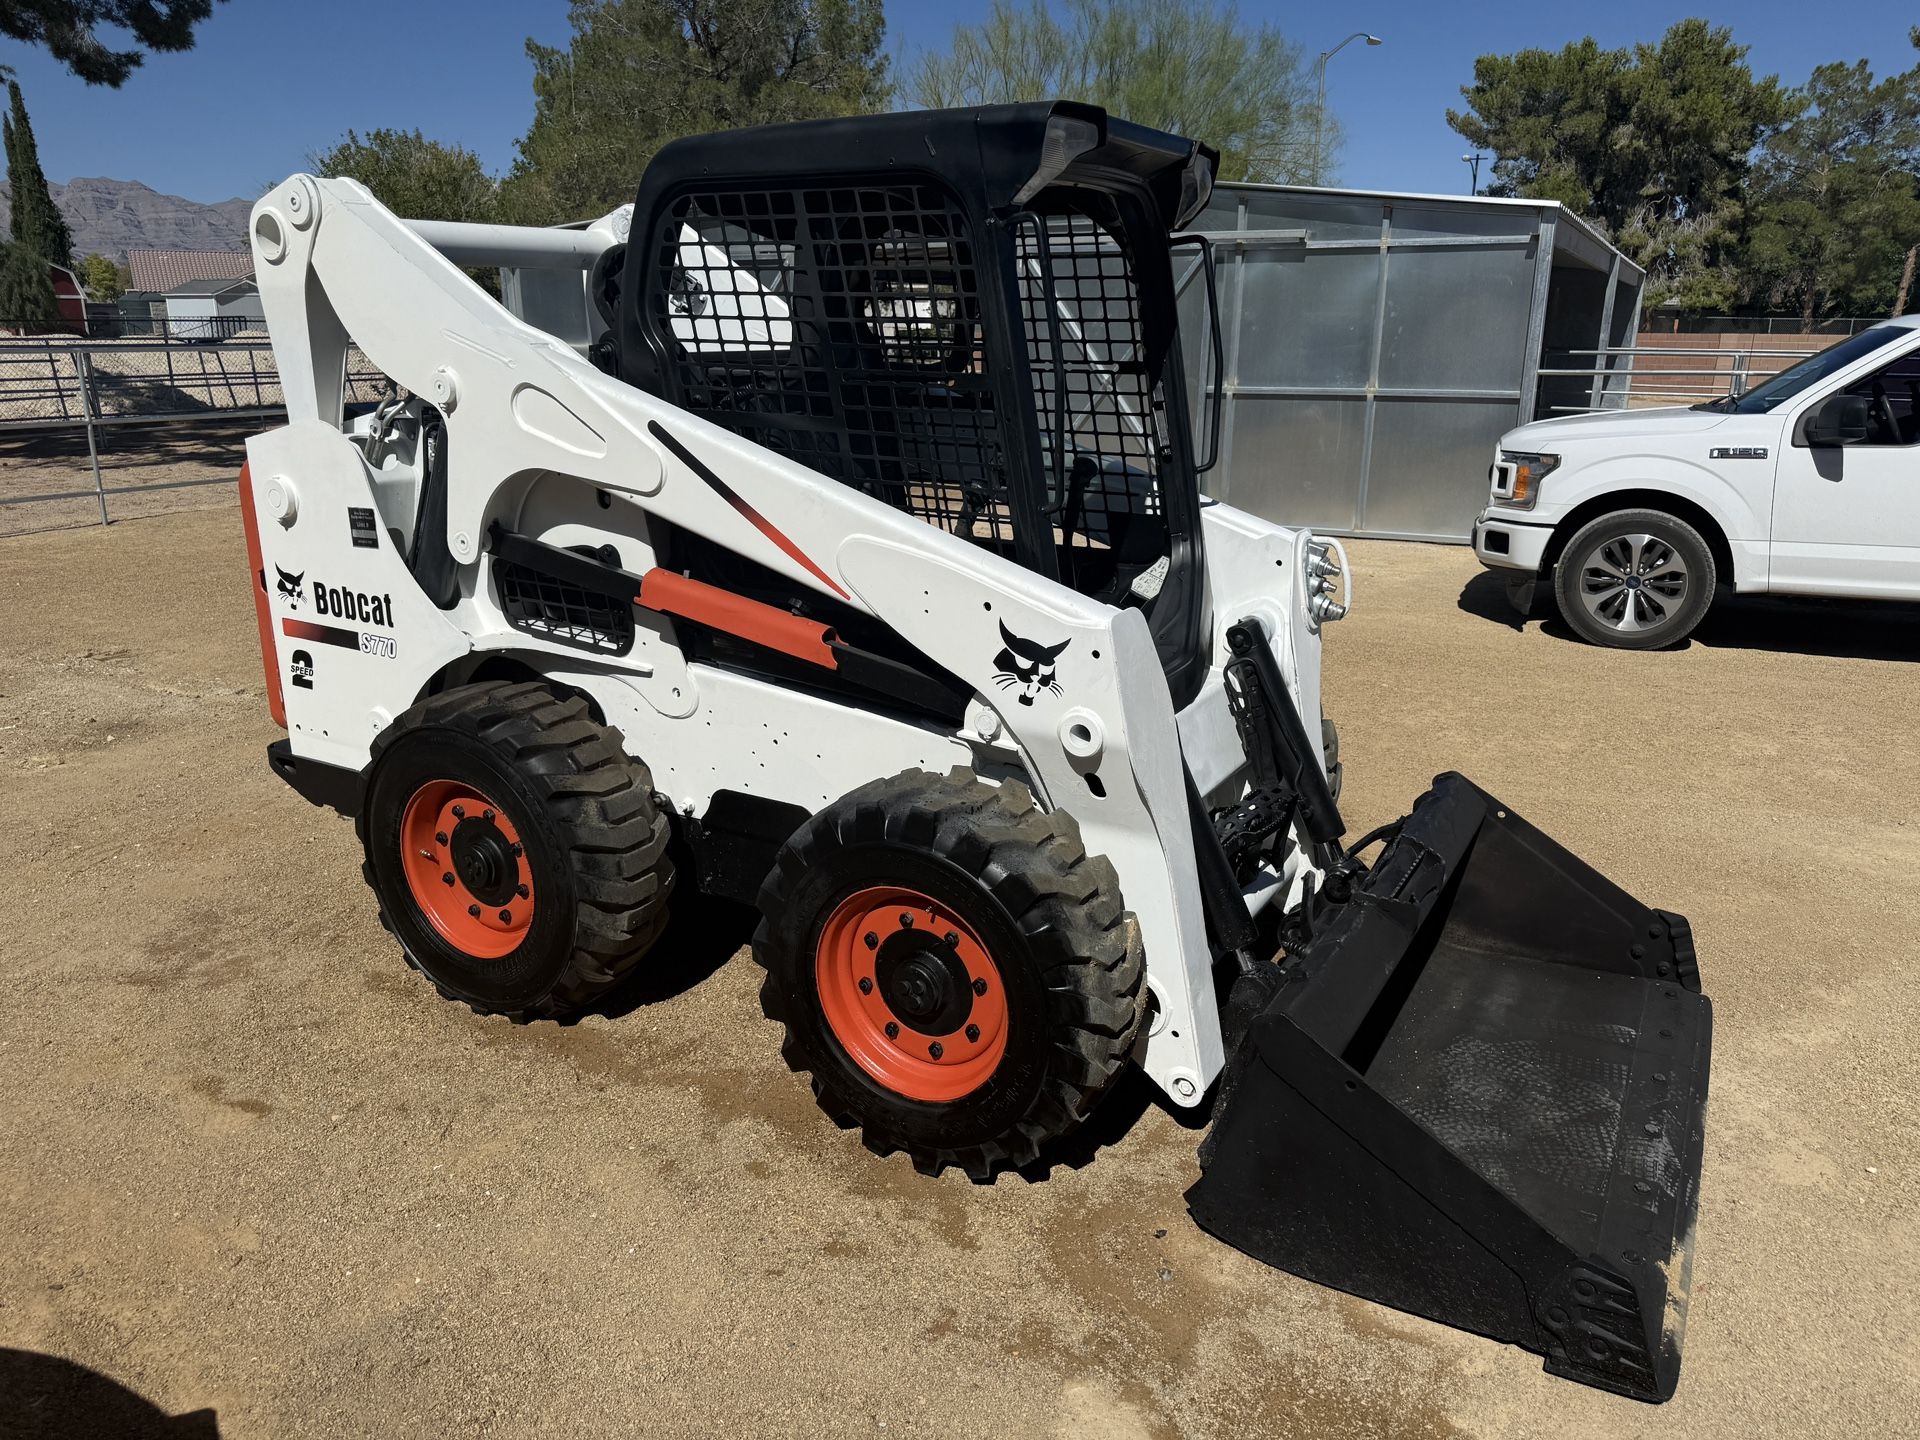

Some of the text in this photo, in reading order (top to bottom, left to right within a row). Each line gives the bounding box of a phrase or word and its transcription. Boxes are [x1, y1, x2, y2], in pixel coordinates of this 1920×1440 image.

[313, 581, 394, 628] Bobcat
[361, 632, 397, 659] S770
[291, 664, 314, 677] SPEED
[292, 649, 313, 690] 2
